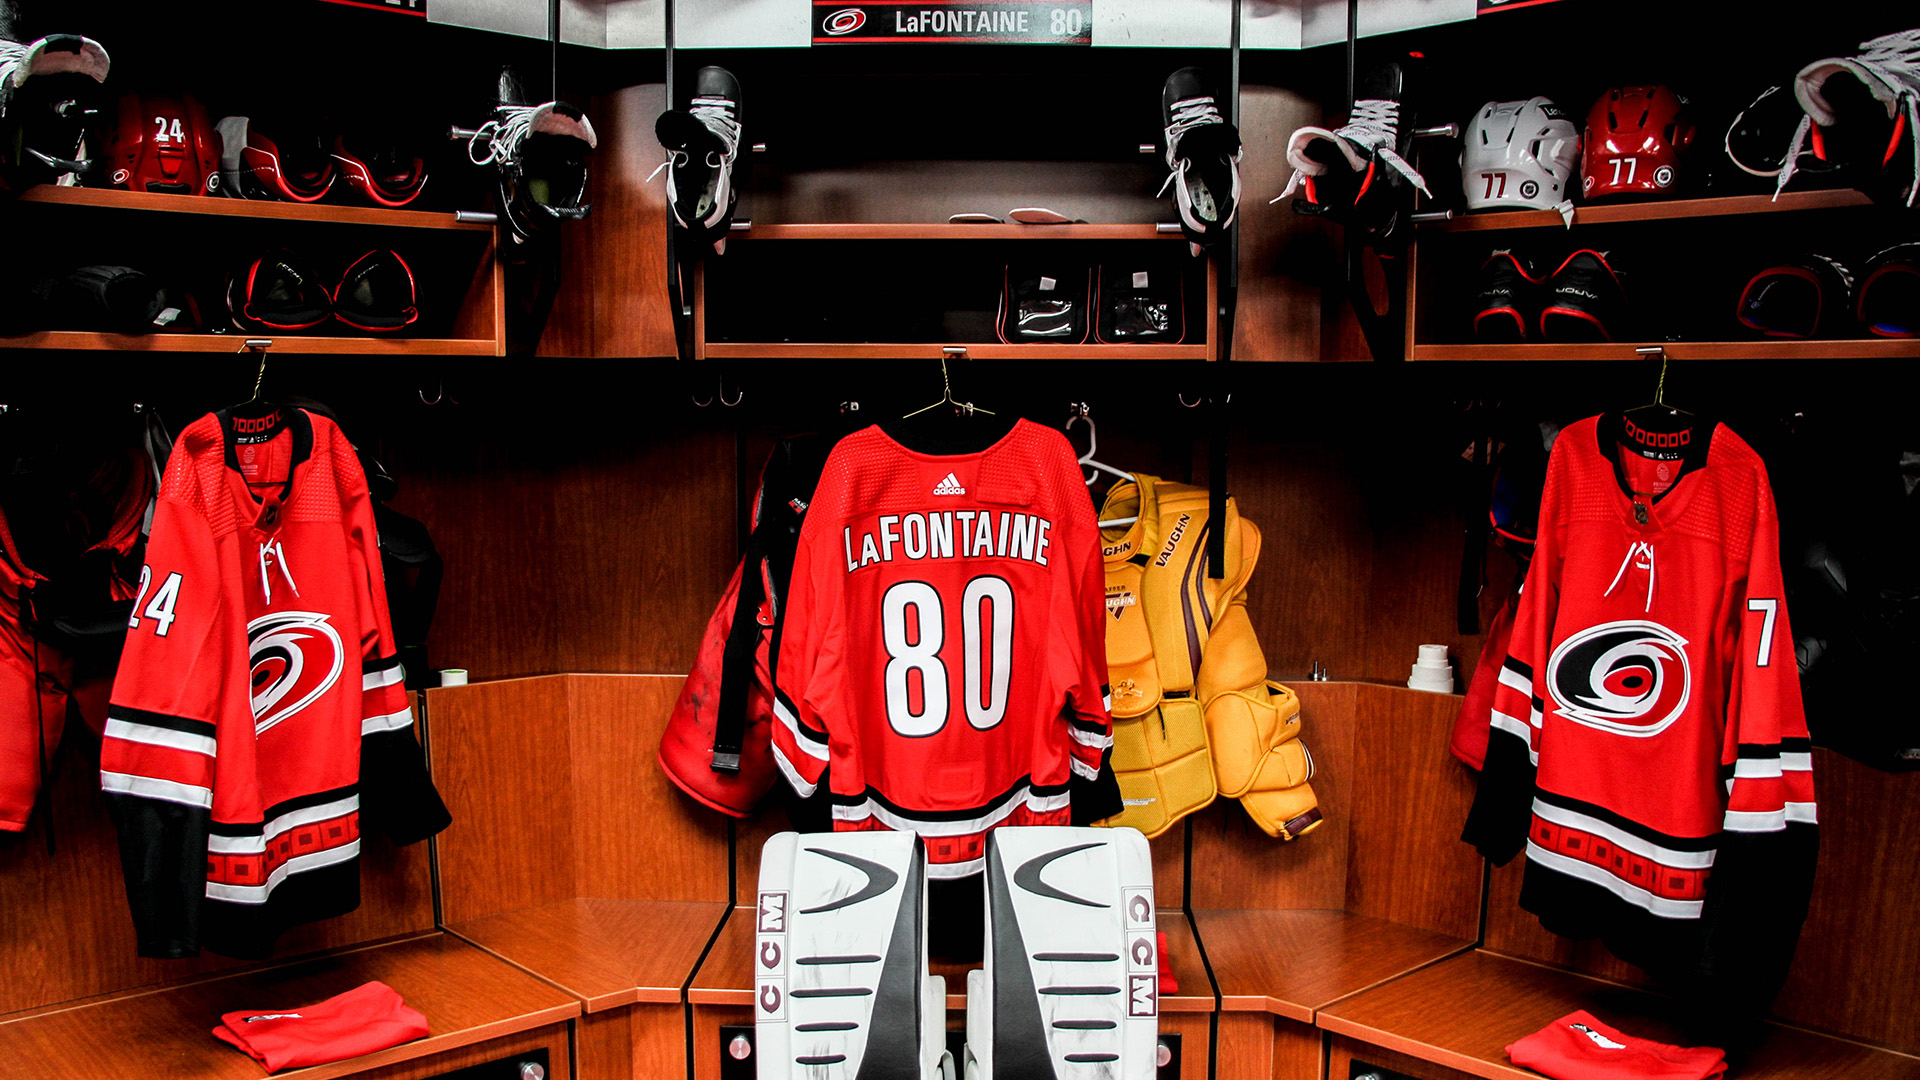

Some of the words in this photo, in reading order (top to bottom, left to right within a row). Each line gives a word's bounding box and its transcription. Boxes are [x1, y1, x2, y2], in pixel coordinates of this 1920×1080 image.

[895, 10, 1029, 33] LaFONTAINE
[1050, 8, 1082, 35] 80
[155, 116, 184, 143] 24
[1481, 172, 1506, 199] 77
[1609, 157, 1637, 186] 77
[933, 486, 966, 496] adidas
[1103, 541, 1131, 557] GHN
[1154, 513, 1191, 568] VAUGHN
[128, 564, 183, 637] 24
[1105, 595, 1136, 607] UGHN
[1747, 598, 1778, 667] 7
[881, 574, 1015, 738] 80
[760, 893, 787, 1014] CCM
[1128, 894, 1157, 1017] CCM
